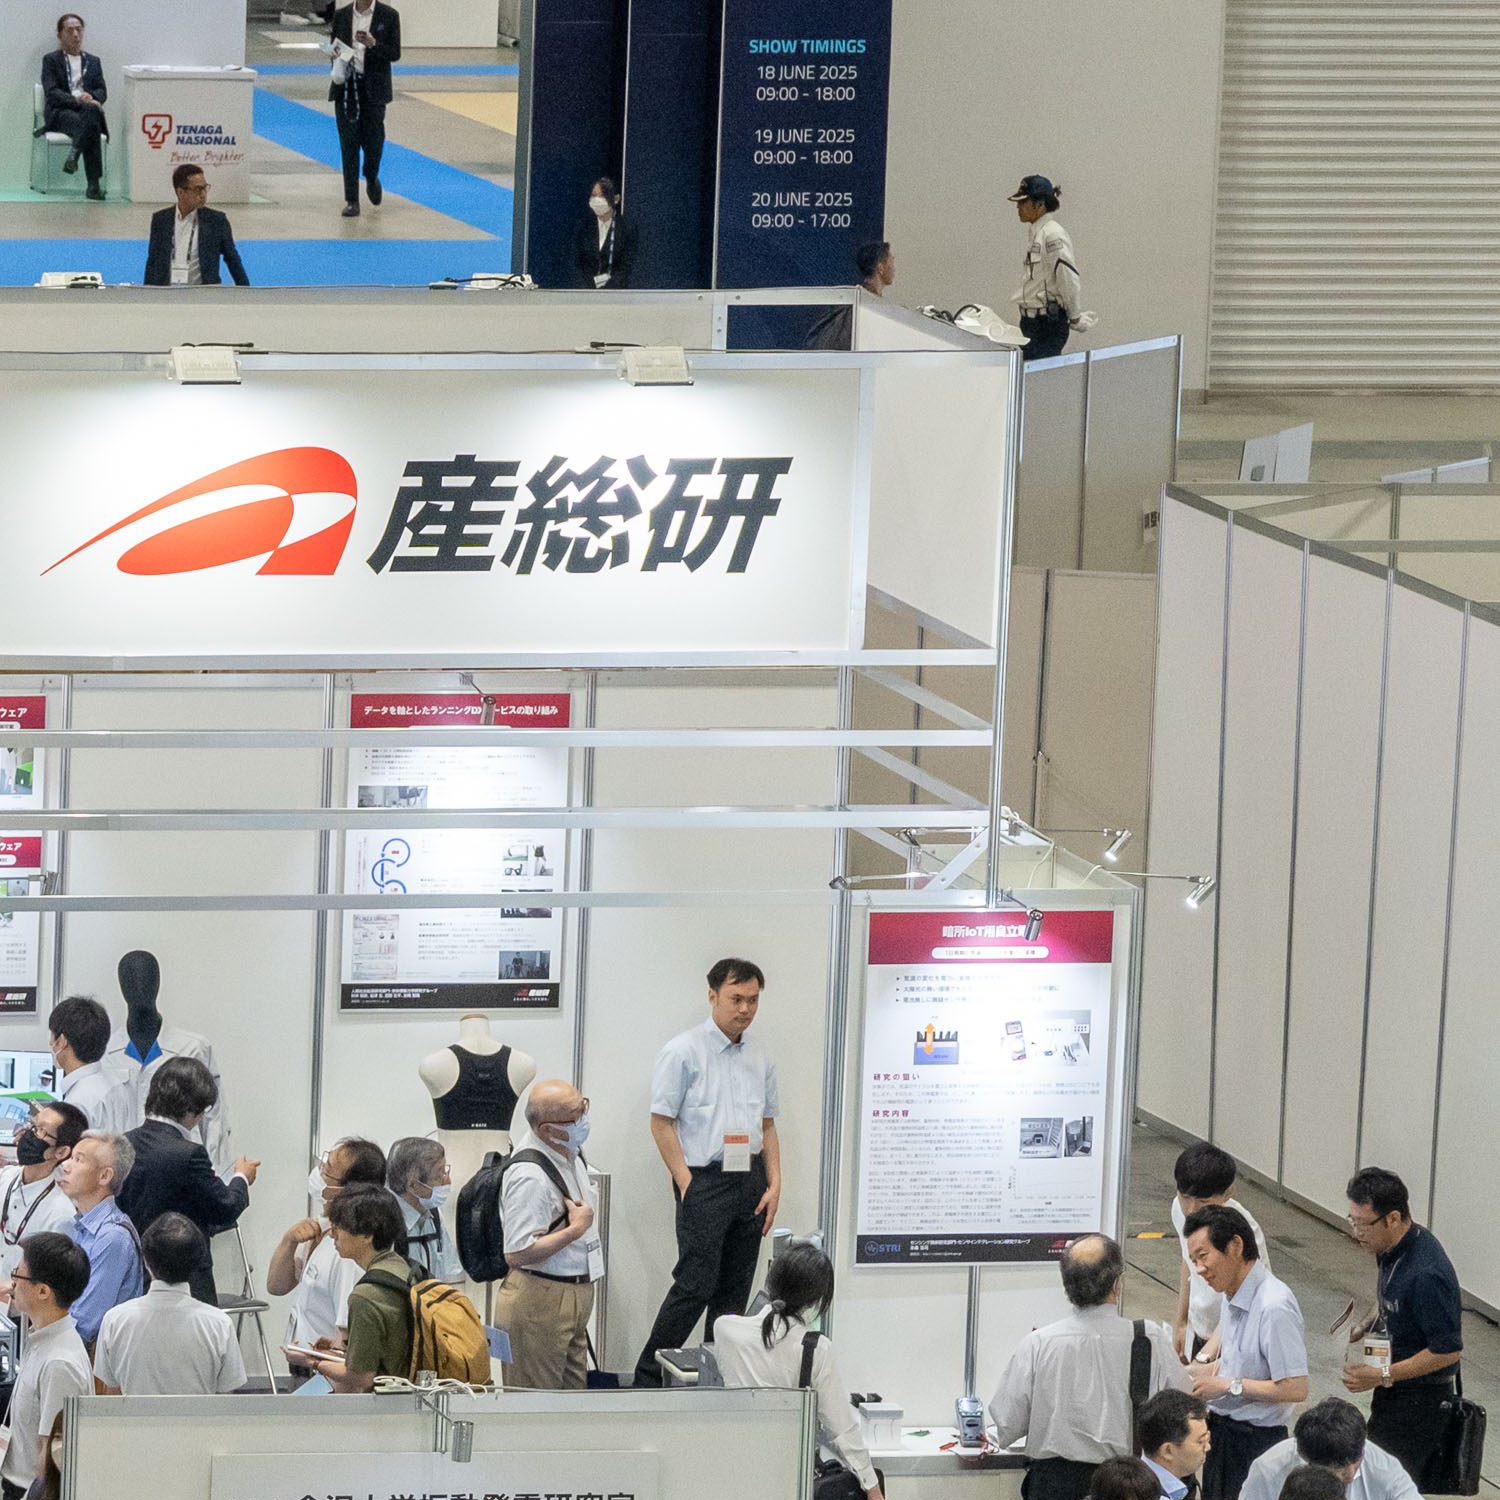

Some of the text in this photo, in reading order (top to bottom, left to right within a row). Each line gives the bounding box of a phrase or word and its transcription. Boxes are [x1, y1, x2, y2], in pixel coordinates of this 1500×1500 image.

[749, 39, 867, 54] SHOW TIMINGS
[757, 65, 858, 81] 18 JUNE 2025
[756, 86, 856, 101] 09:00 18:00
[175, 125, 223, 135] TENAGA
[755, 128, 856, 145] 19 JUNE 2025
[175, 136, 237, 146] NASIONAL
[754, 150, 853, 165] 09:00 18:00
[752, 192, 853, 208] 20 JUNE 2025
[752, 213, 851, 228] 09:00 17:00
[367, 453, 793, 575] 産総研
